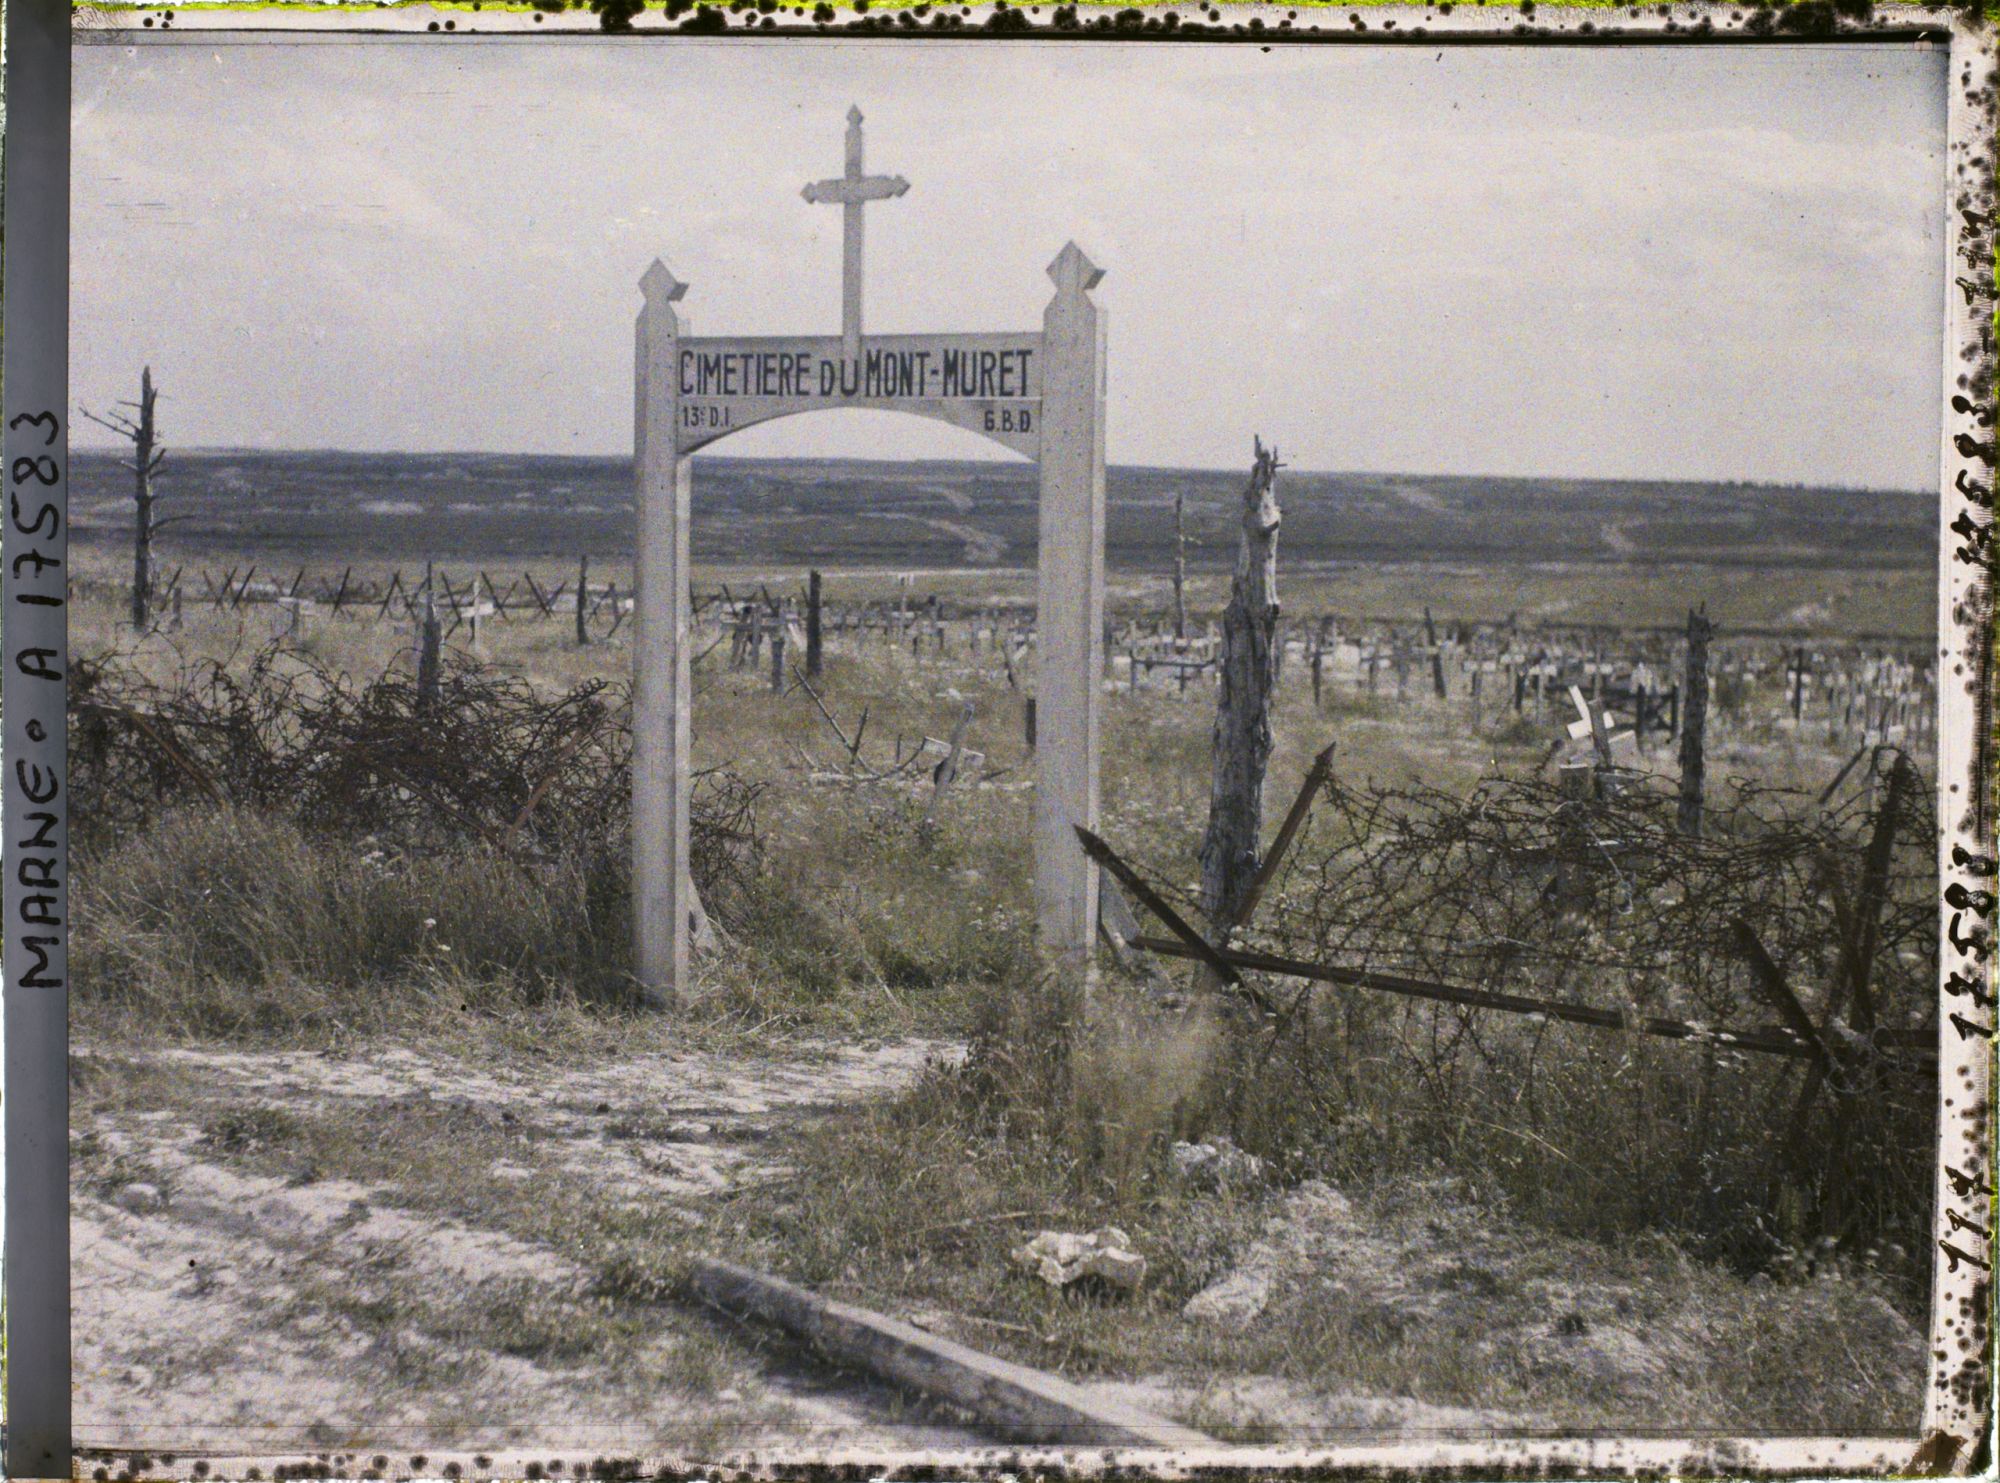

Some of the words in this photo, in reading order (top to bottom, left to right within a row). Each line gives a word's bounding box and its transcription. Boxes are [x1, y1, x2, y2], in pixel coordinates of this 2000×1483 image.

[680, 350, 811, 396] CIMETIERE
[820, 359, 859, 397] DU
[865, 348, 1033, 397] MONT-MURET
[10, 411, 64, 605] 17583
[15, 647, 63, 681] A
[16, 757, 63, 989] MARNE
